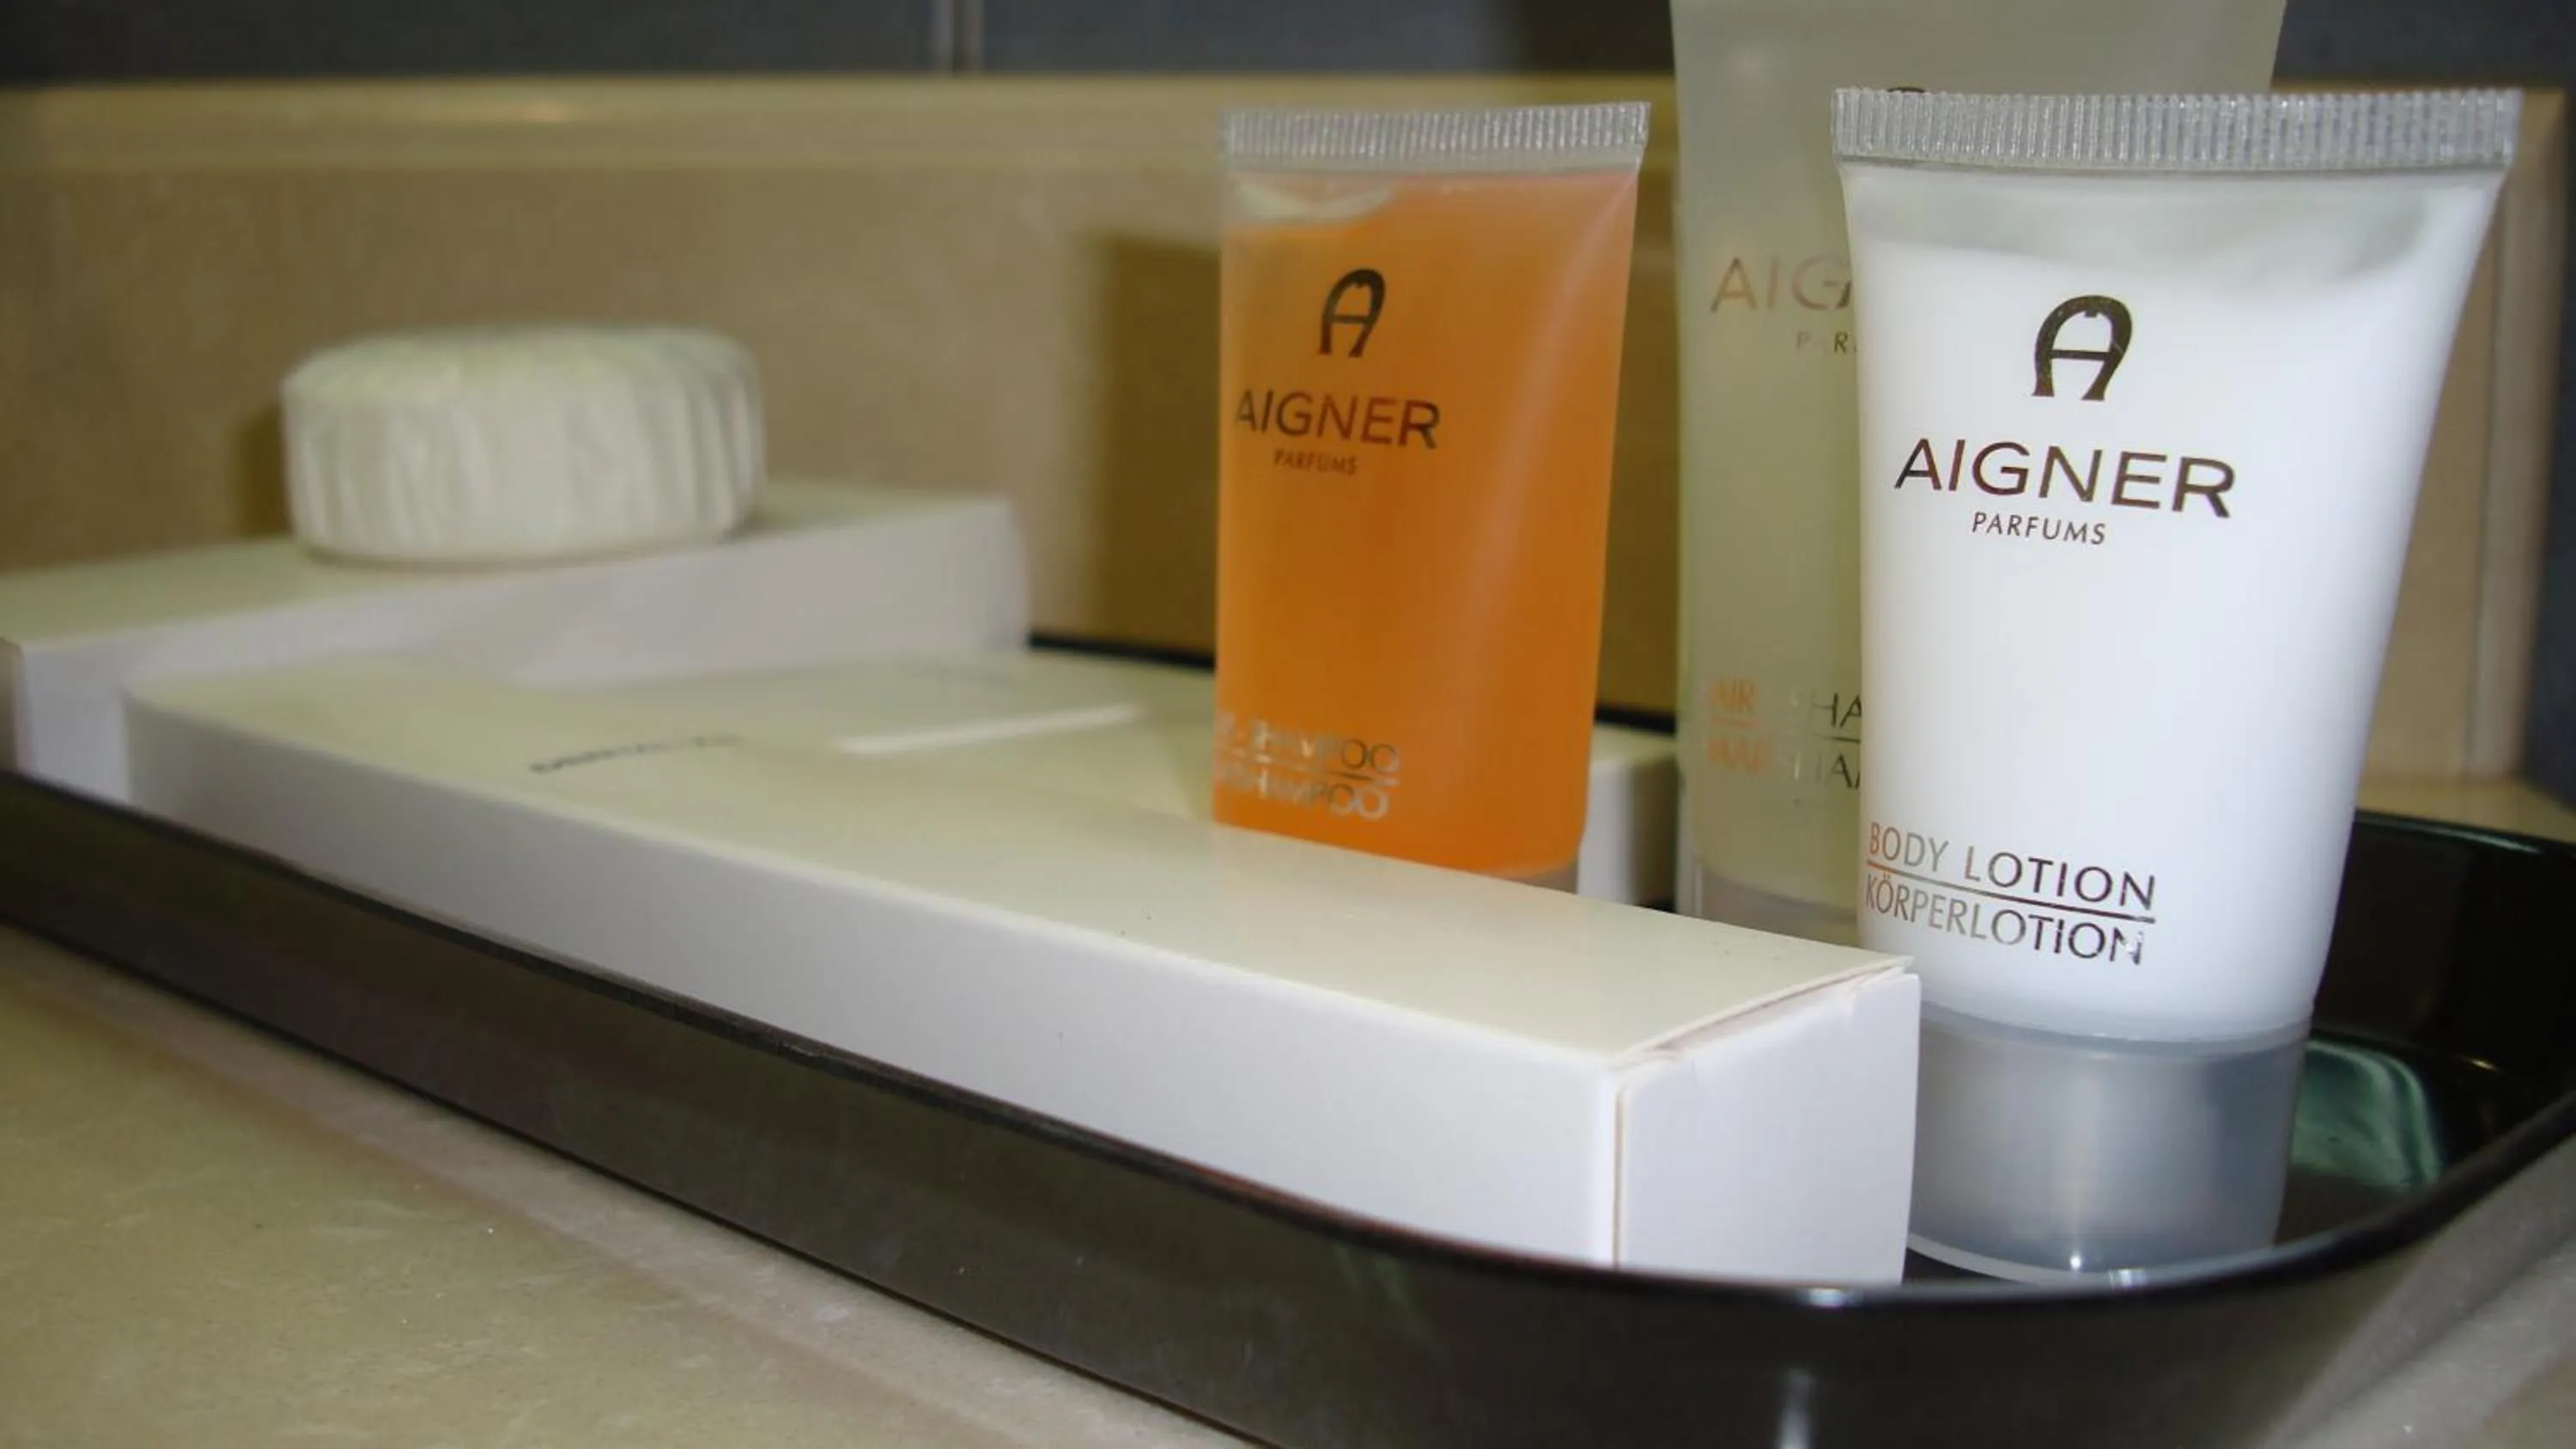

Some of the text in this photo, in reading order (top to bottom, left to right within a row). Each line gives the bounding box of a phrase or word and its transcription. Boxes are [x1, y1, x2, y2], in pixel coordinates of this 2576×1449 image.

[1235, 389, 1441, 449] AIGNER
[1274, 451, 1358, 476] PARFUMS
[1894, 438, 2236, 518] AIGNER
[1971, 511, 2106, 545] PARFUMS
[1868, 822, 2155, 911] BODY LOTION
[1866, 870, 2144, 965] KÖRPERLOTION
